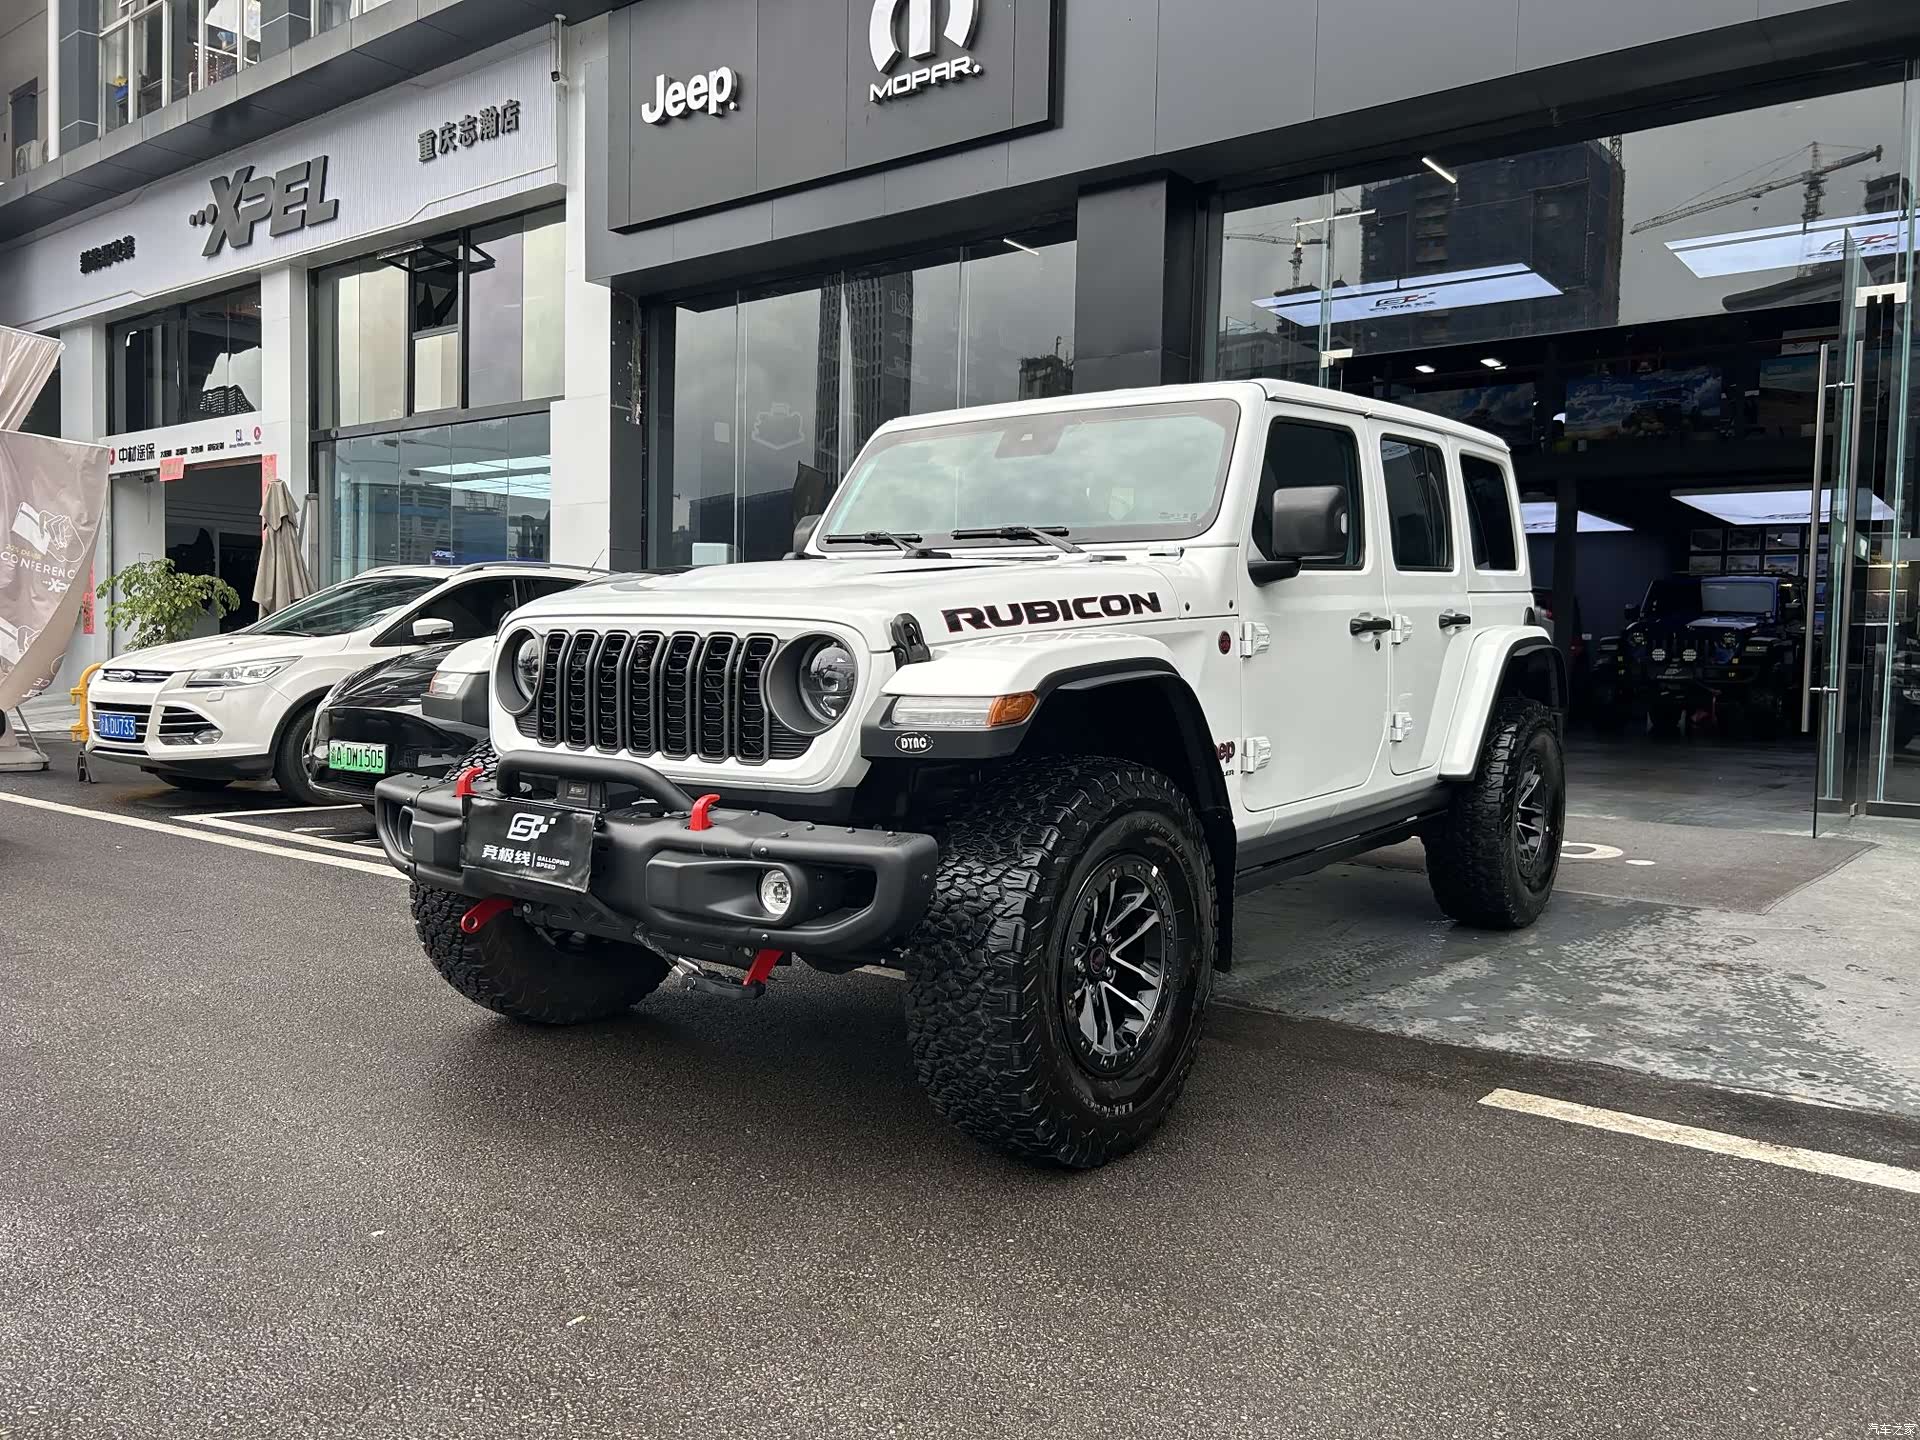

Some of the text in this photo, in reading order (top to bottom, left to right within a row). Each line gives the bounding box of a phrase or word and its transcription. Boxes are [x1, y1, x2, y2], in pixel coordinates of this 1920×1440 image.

[418, 99, 521, 163] 重庆志瀚店
[201, 154, 340, 258] XPEL
[940, 591, 1162, 633] RUBICON
[1215, 741, 1236, 764] ep
[535, 861, 556, 870] SPEED
